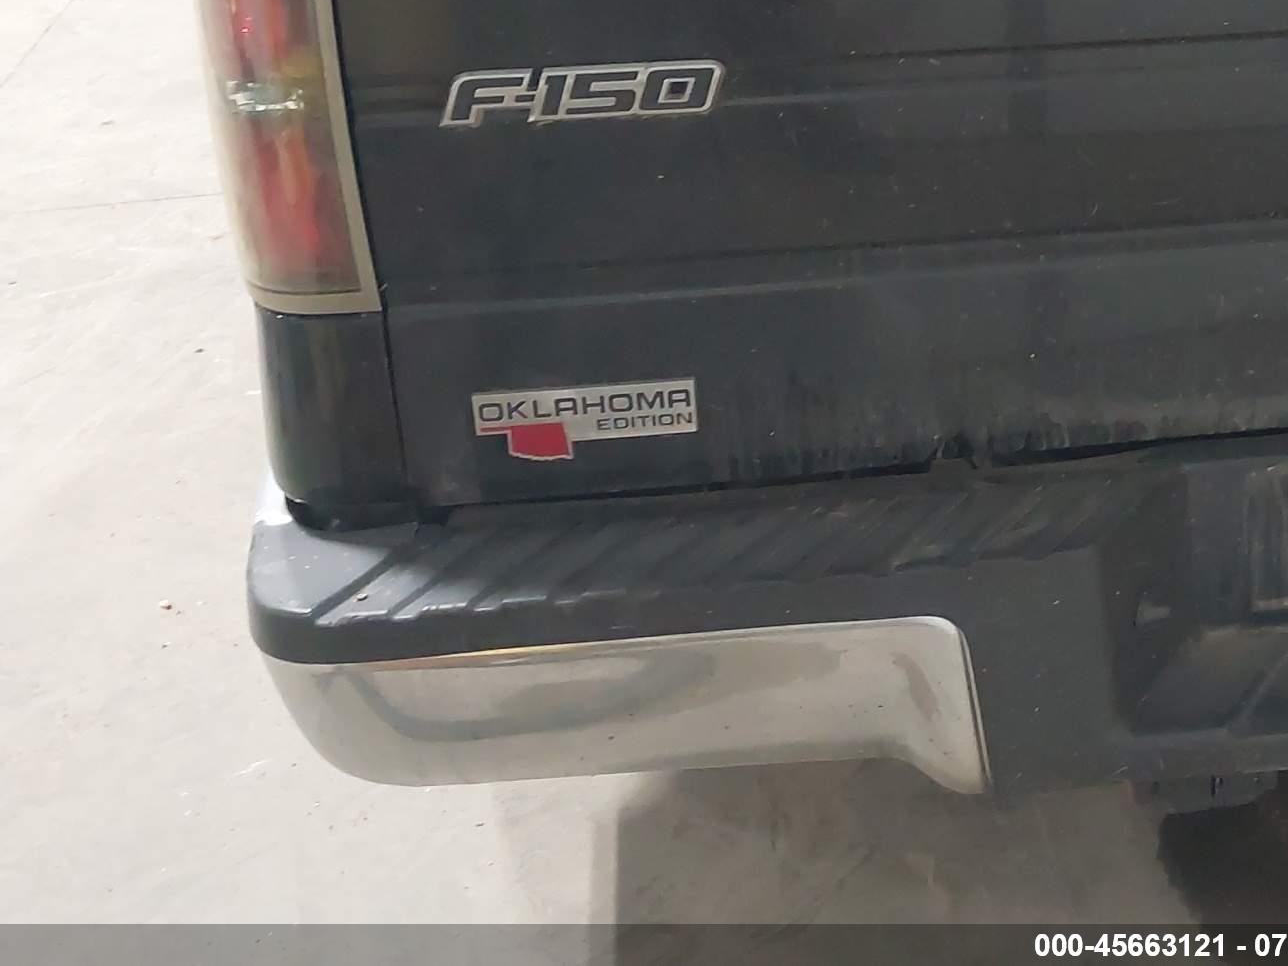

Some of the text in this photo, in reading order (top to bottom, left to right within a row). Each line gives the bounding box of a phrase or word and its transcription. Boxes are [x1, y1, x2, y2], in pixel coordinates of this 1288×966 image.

[440, 60, 726, 128] F-150
[477, 388, 692, 423] OKLAHOMA
[596, 412, 693, 431] EDITION
